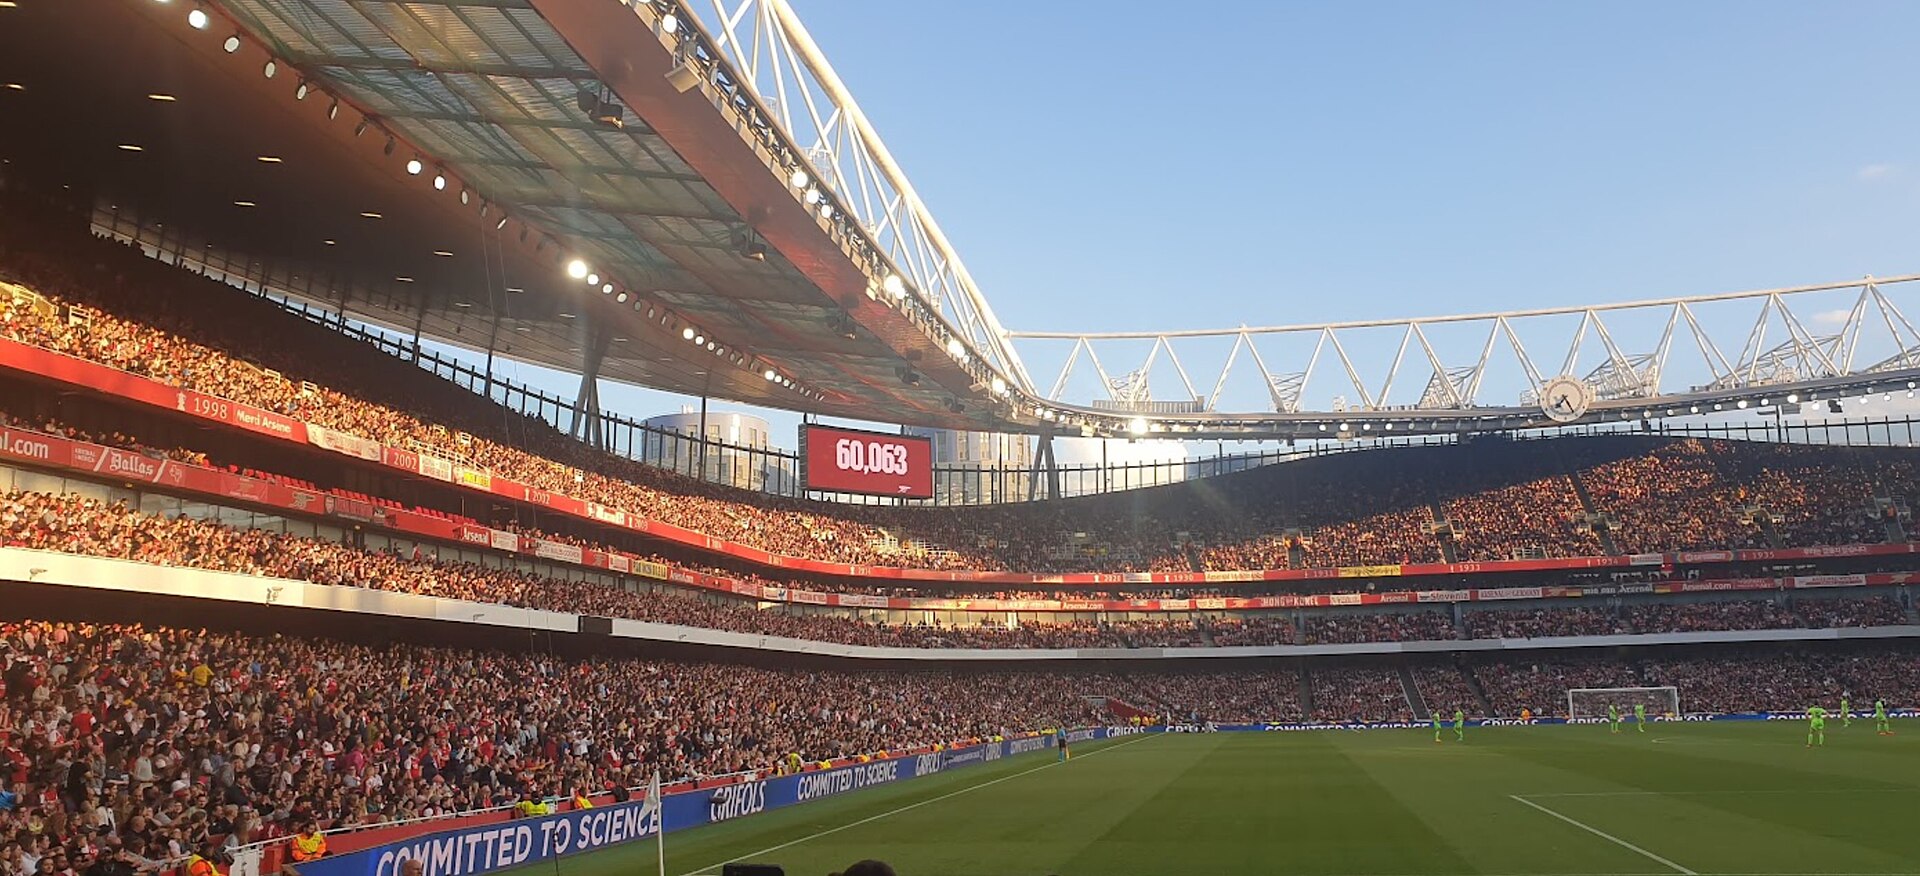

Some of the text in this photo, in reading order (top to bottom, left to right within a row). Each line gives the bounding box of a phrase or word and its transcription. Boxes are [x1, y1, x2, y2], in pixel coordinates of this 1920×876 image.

[194, 397, 227, 420] 1998
[0, 432, 48, 459] l.com
[110, 449, 154, 476] Dallas
[393, 452, 417, 470] 2002
[836, 438, 908, 475] 60,063
[463, 527, 490, 545] Arsenal
[1596, 557, 1618, 567] 1934
[1751, 551, 1775, 561] 1935
[1458, 564, 1481, 573] 1933
[1682, 581, 1732, 591] Arsenal.com
[1380, 594, 1409, 603] Arsenal
[797, 761, 898, 801] COMMITTED TO SCIENCE
[711, 781, 768, 823] GRIFOLS
[540, 818, 571, 854] TO
[576, 801, 662, 850] SCIENCE
